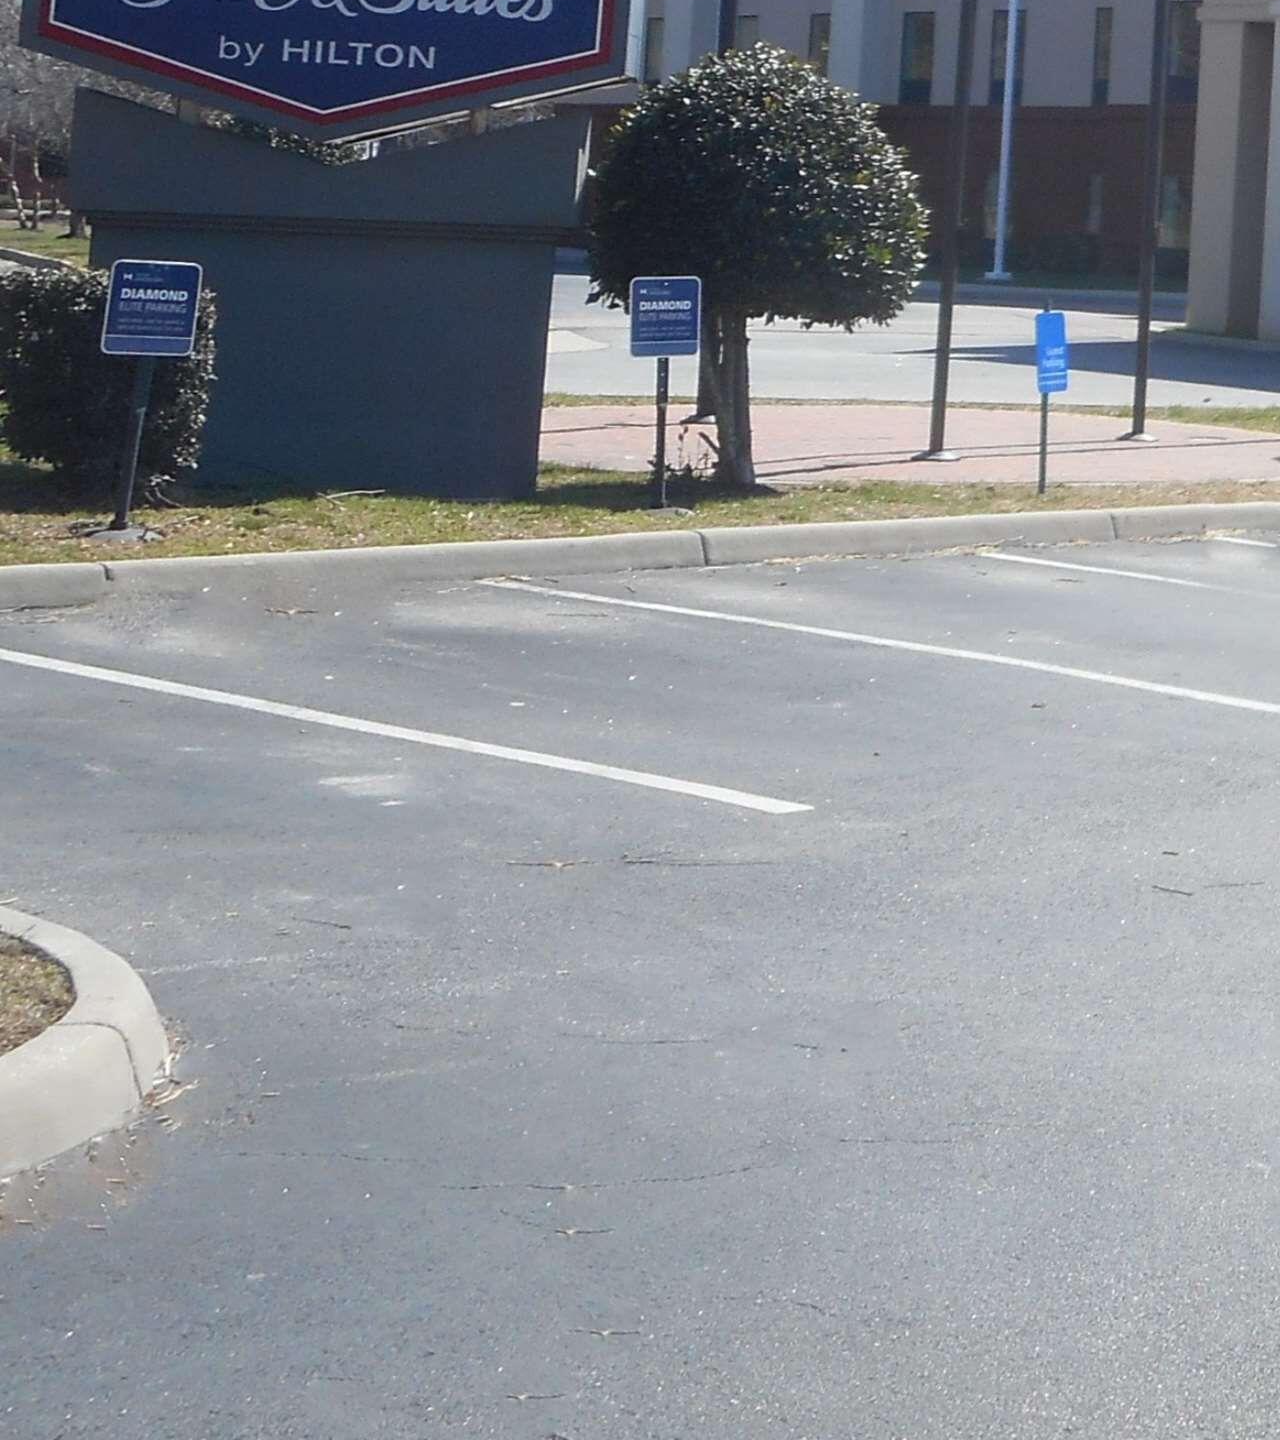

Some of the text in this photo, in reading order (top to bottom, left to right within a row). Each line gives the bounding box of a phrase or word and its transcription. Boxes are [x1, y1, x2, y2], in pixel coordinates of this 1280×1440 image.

[218, 35, 436, 69] by HILTON
[121, 288, 188, 301] DIAMOND
[640, 300, 692, 310] DIAMOND
